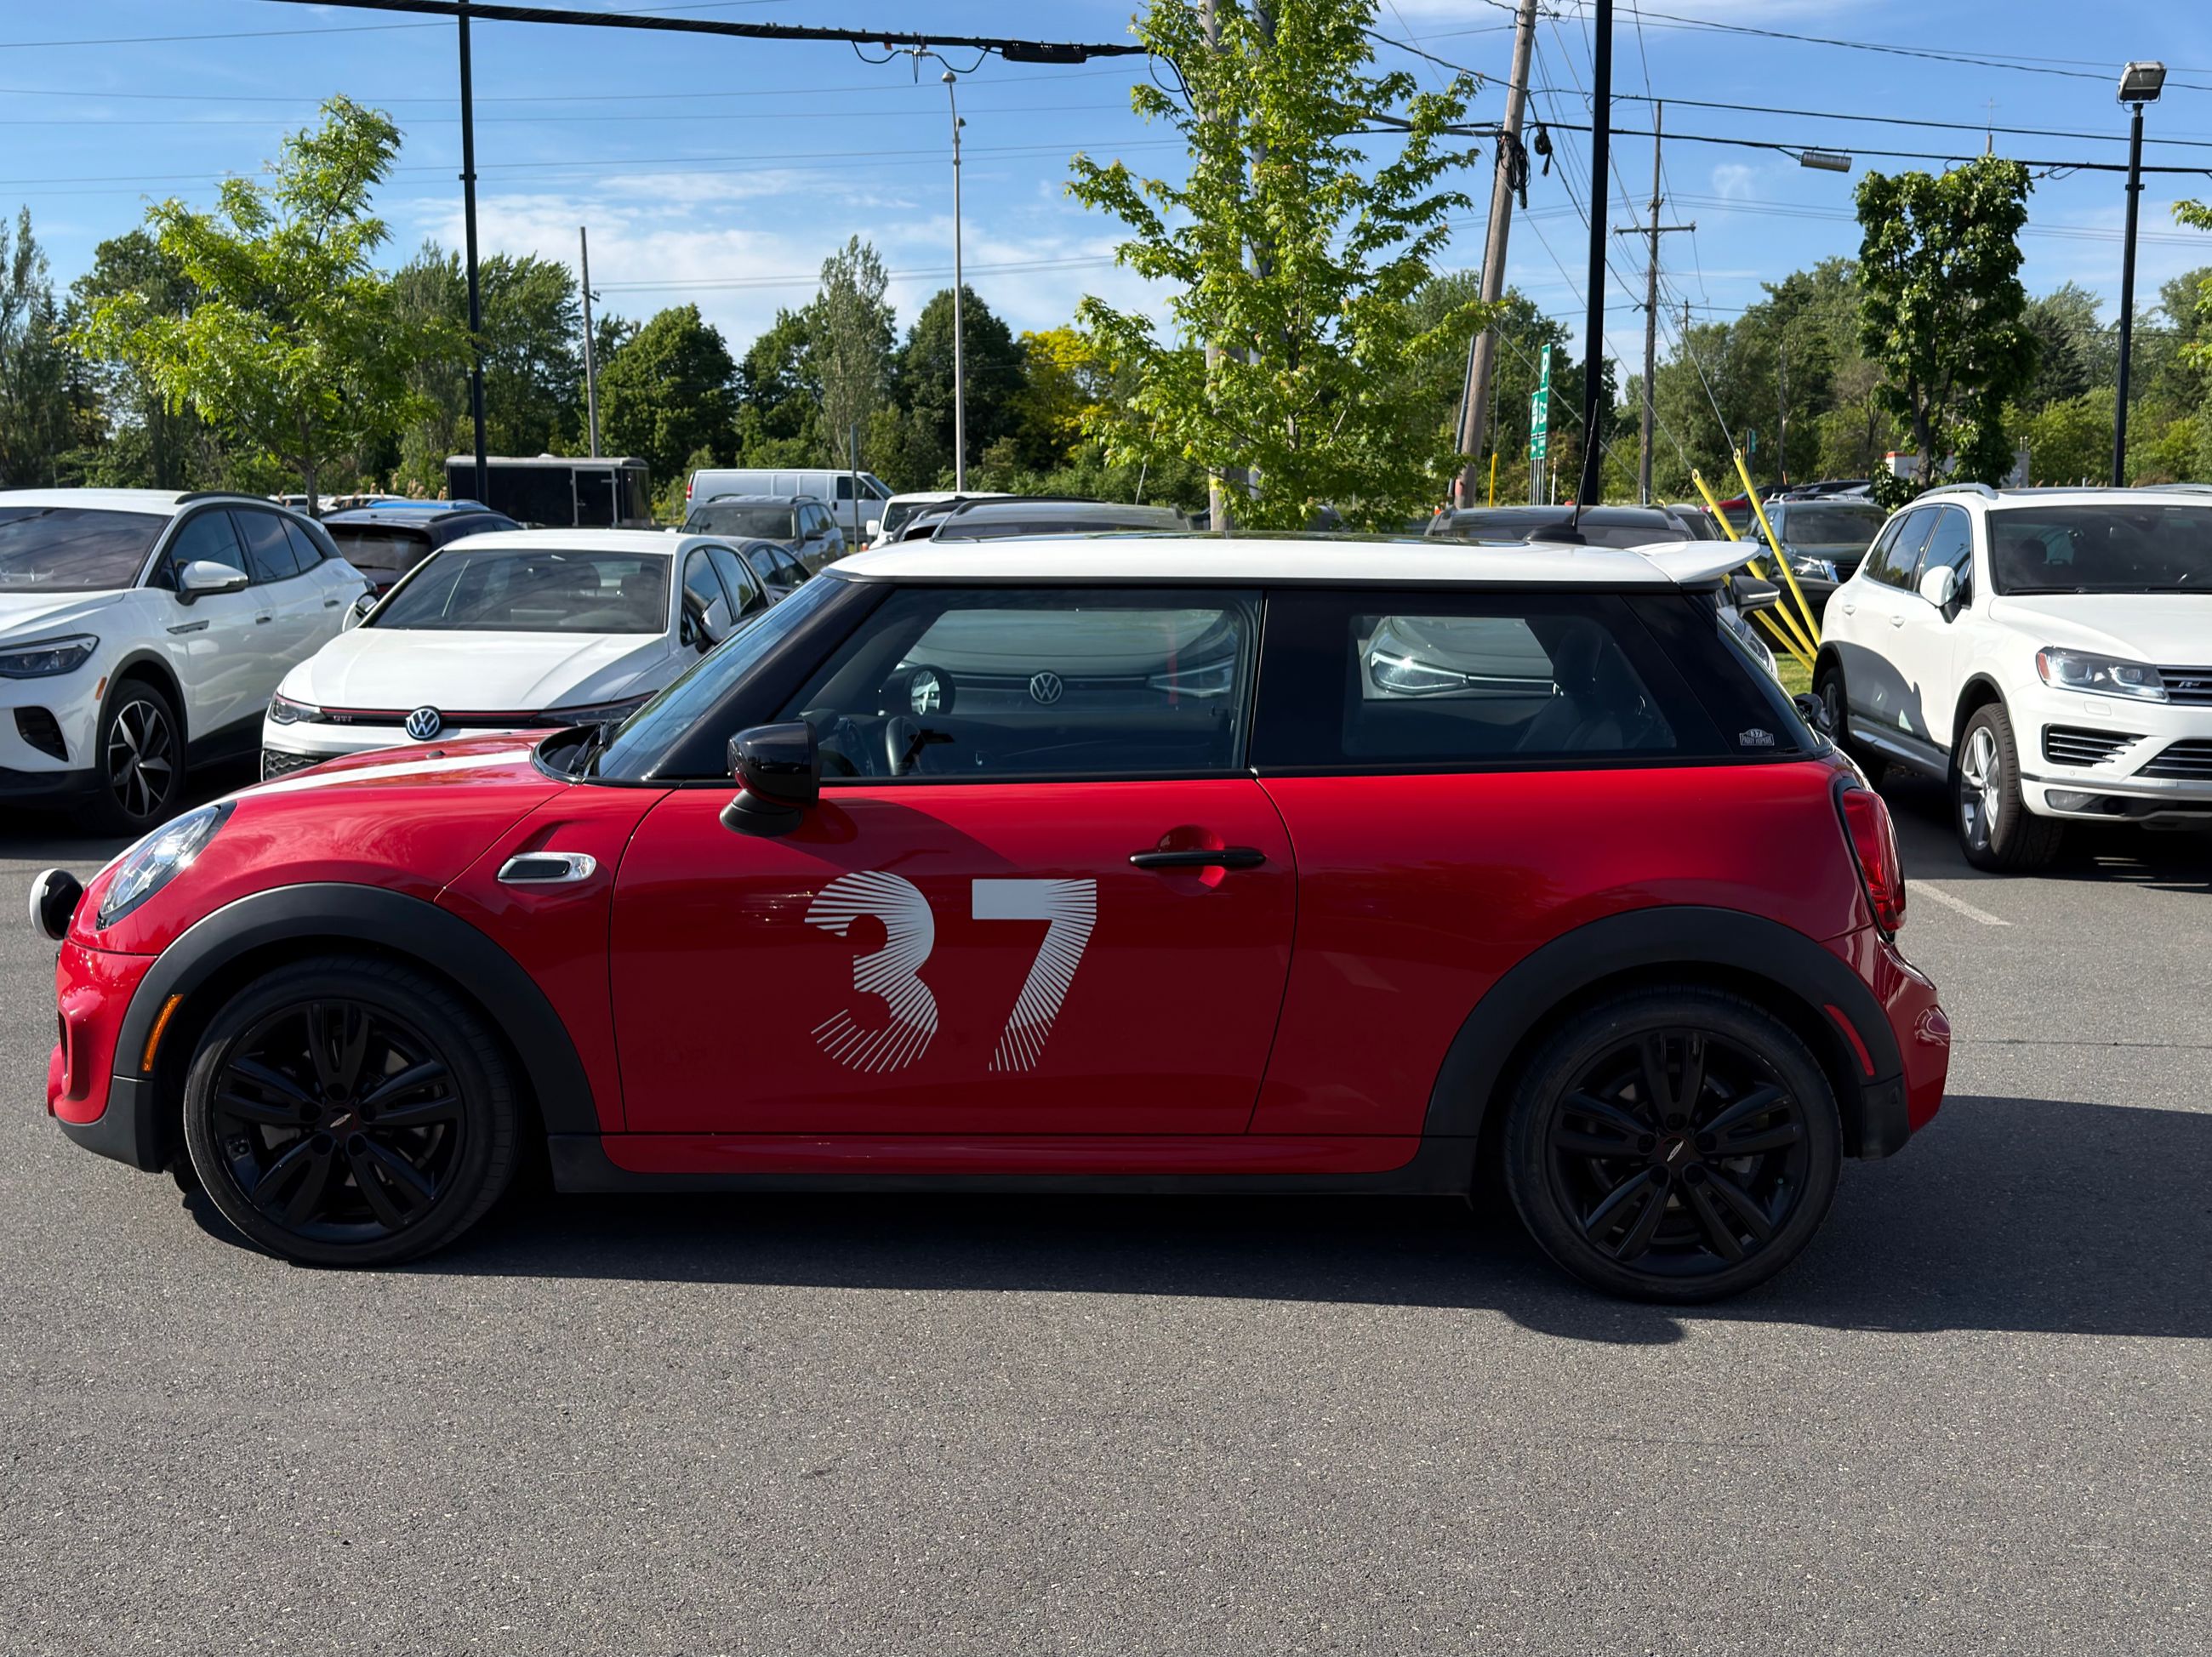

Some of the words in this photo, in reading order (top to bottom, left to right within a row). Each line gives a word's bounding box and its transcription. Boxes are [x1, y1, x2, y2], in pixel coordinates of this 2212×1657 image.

[1542, 351, 1548, 383] P
[408, 708, 440, 739] VW
[804, 870, 1098, 1073] 37
